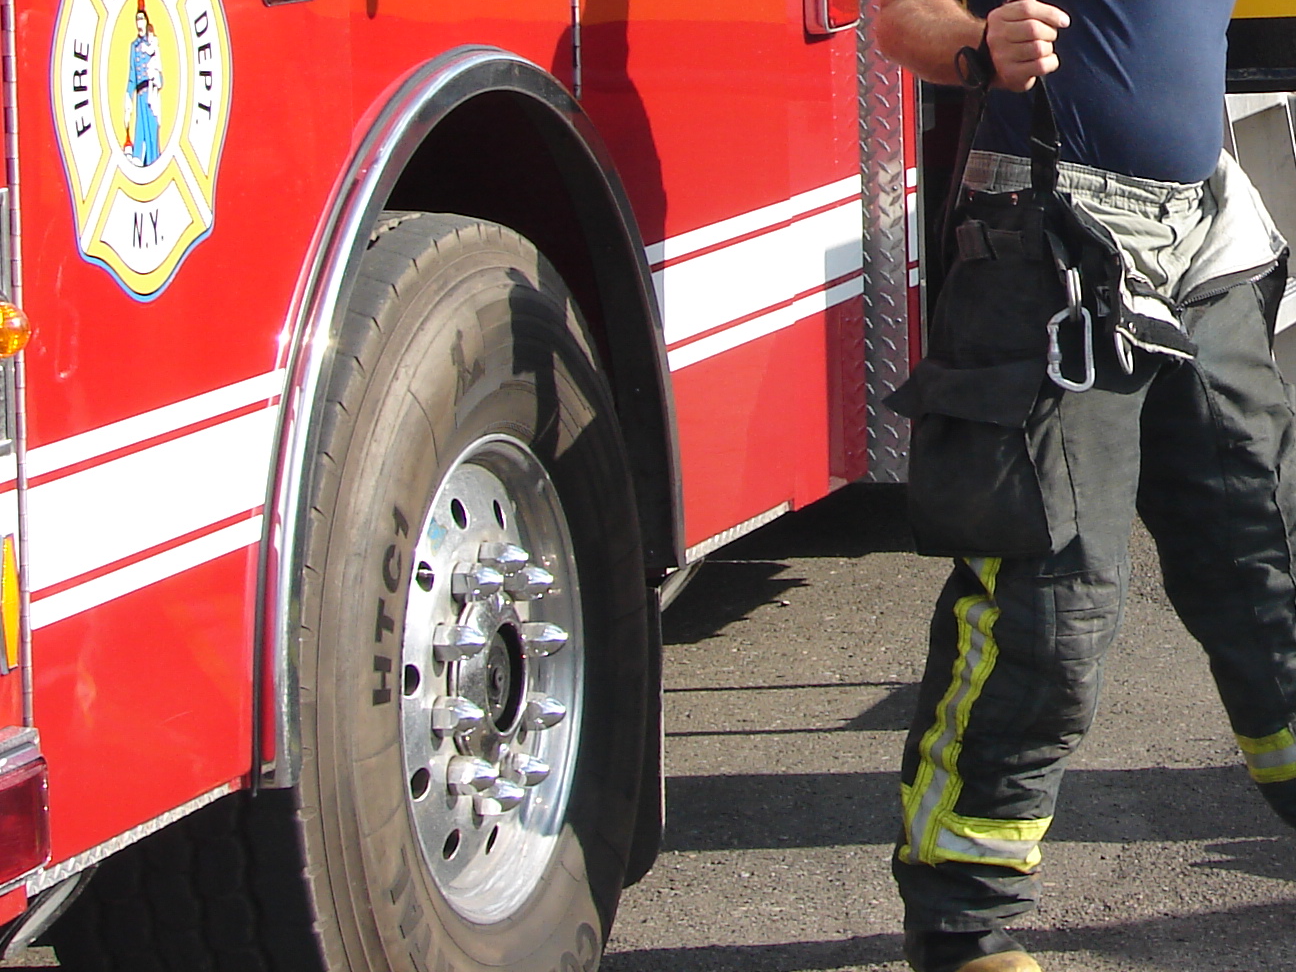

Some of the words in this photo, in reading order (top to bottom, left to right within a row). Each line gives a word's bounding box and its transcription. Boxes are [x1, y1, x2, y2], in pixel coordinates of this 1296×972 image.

[73, 38, 92, 138] FIRE
[193, 9, 214, 125] DEPT.
[132, 208, 164, 250] N.Y.
